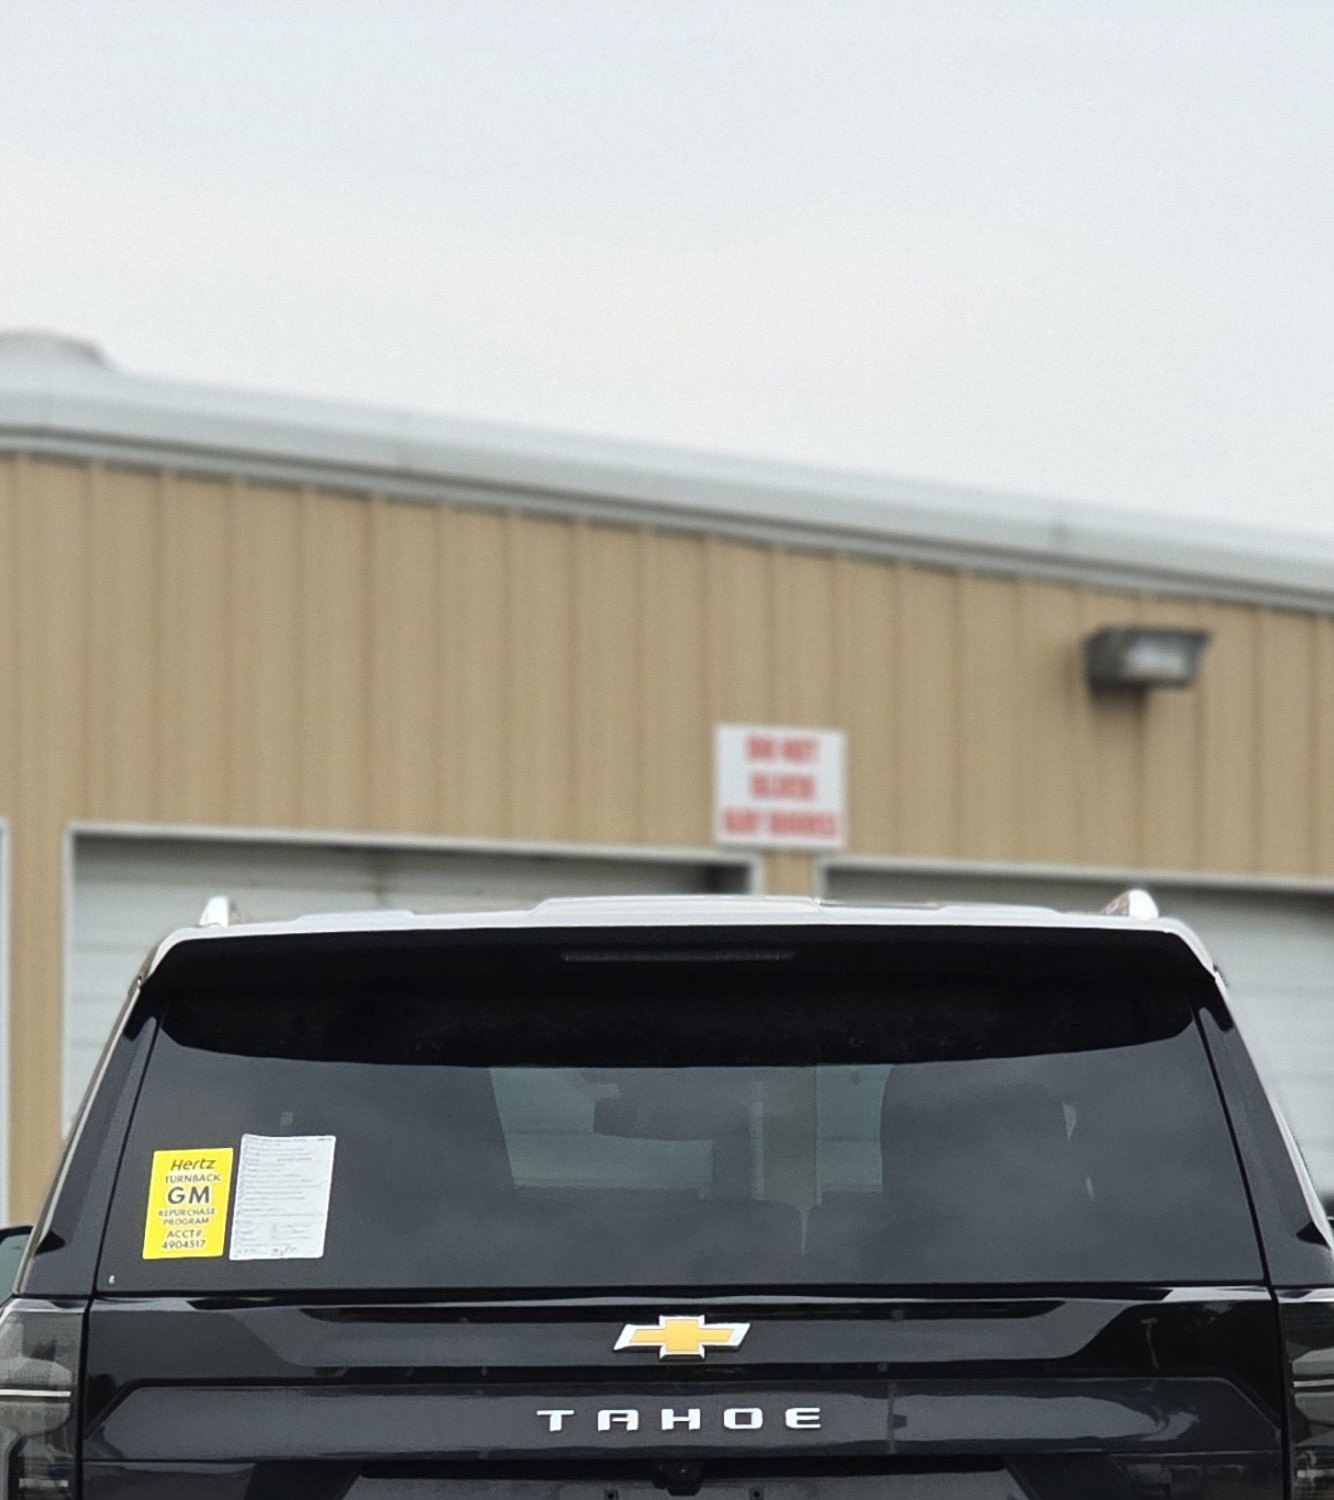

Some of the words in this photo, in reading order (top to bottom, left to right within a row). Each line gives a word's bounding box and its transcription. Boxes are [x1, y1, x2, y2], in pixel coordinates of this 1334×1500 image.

[170, 1158, 216, 1171] Hertz
[165, 1173, 221, 1184] TURNBACK
[168, 1186, 210, 1204] GM
[158, 1207, 215, 1217] REPURCHASE
[163, 1217, 210, 1226] PROGRAM
[536, 1408, 821, 1431] TAHOE
